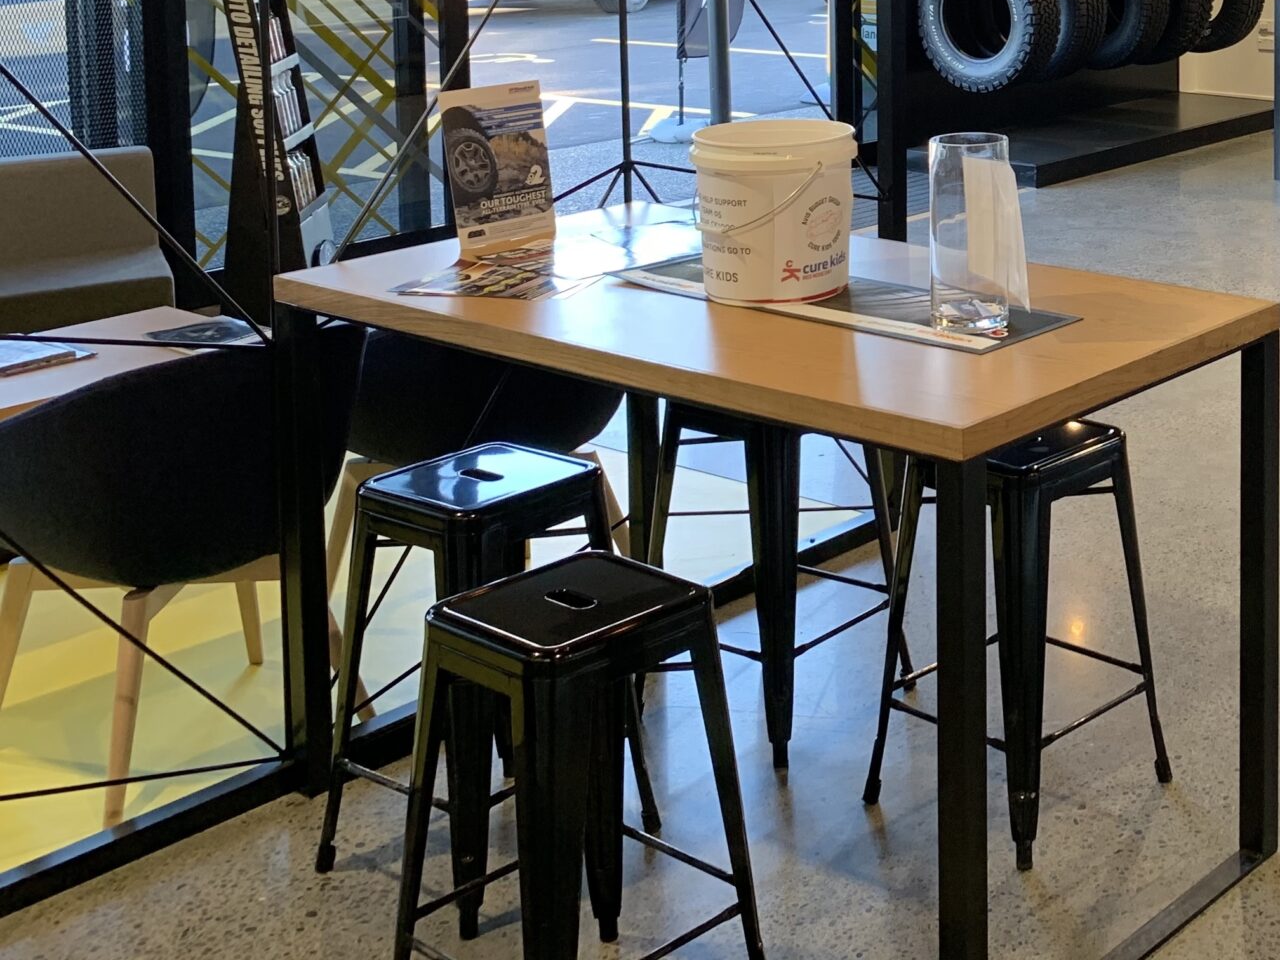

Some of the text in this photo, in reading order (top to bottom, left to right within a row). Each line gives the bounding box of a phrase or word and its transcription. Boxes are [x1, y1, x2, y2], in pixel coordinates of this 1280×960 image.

[232, 25, 264, 106] DETAILING
[480, 198, 500, 209] OUR
[501, 190, 546, 205] TOUGHEST
[714, 197, 748, 207] SUPPORT
[727, 246, 738, 255] GO
[739, 246, 752, 255] TO
[802, 250, 847, 275] cure kids
[715, 270, 739, 283] KIDS
